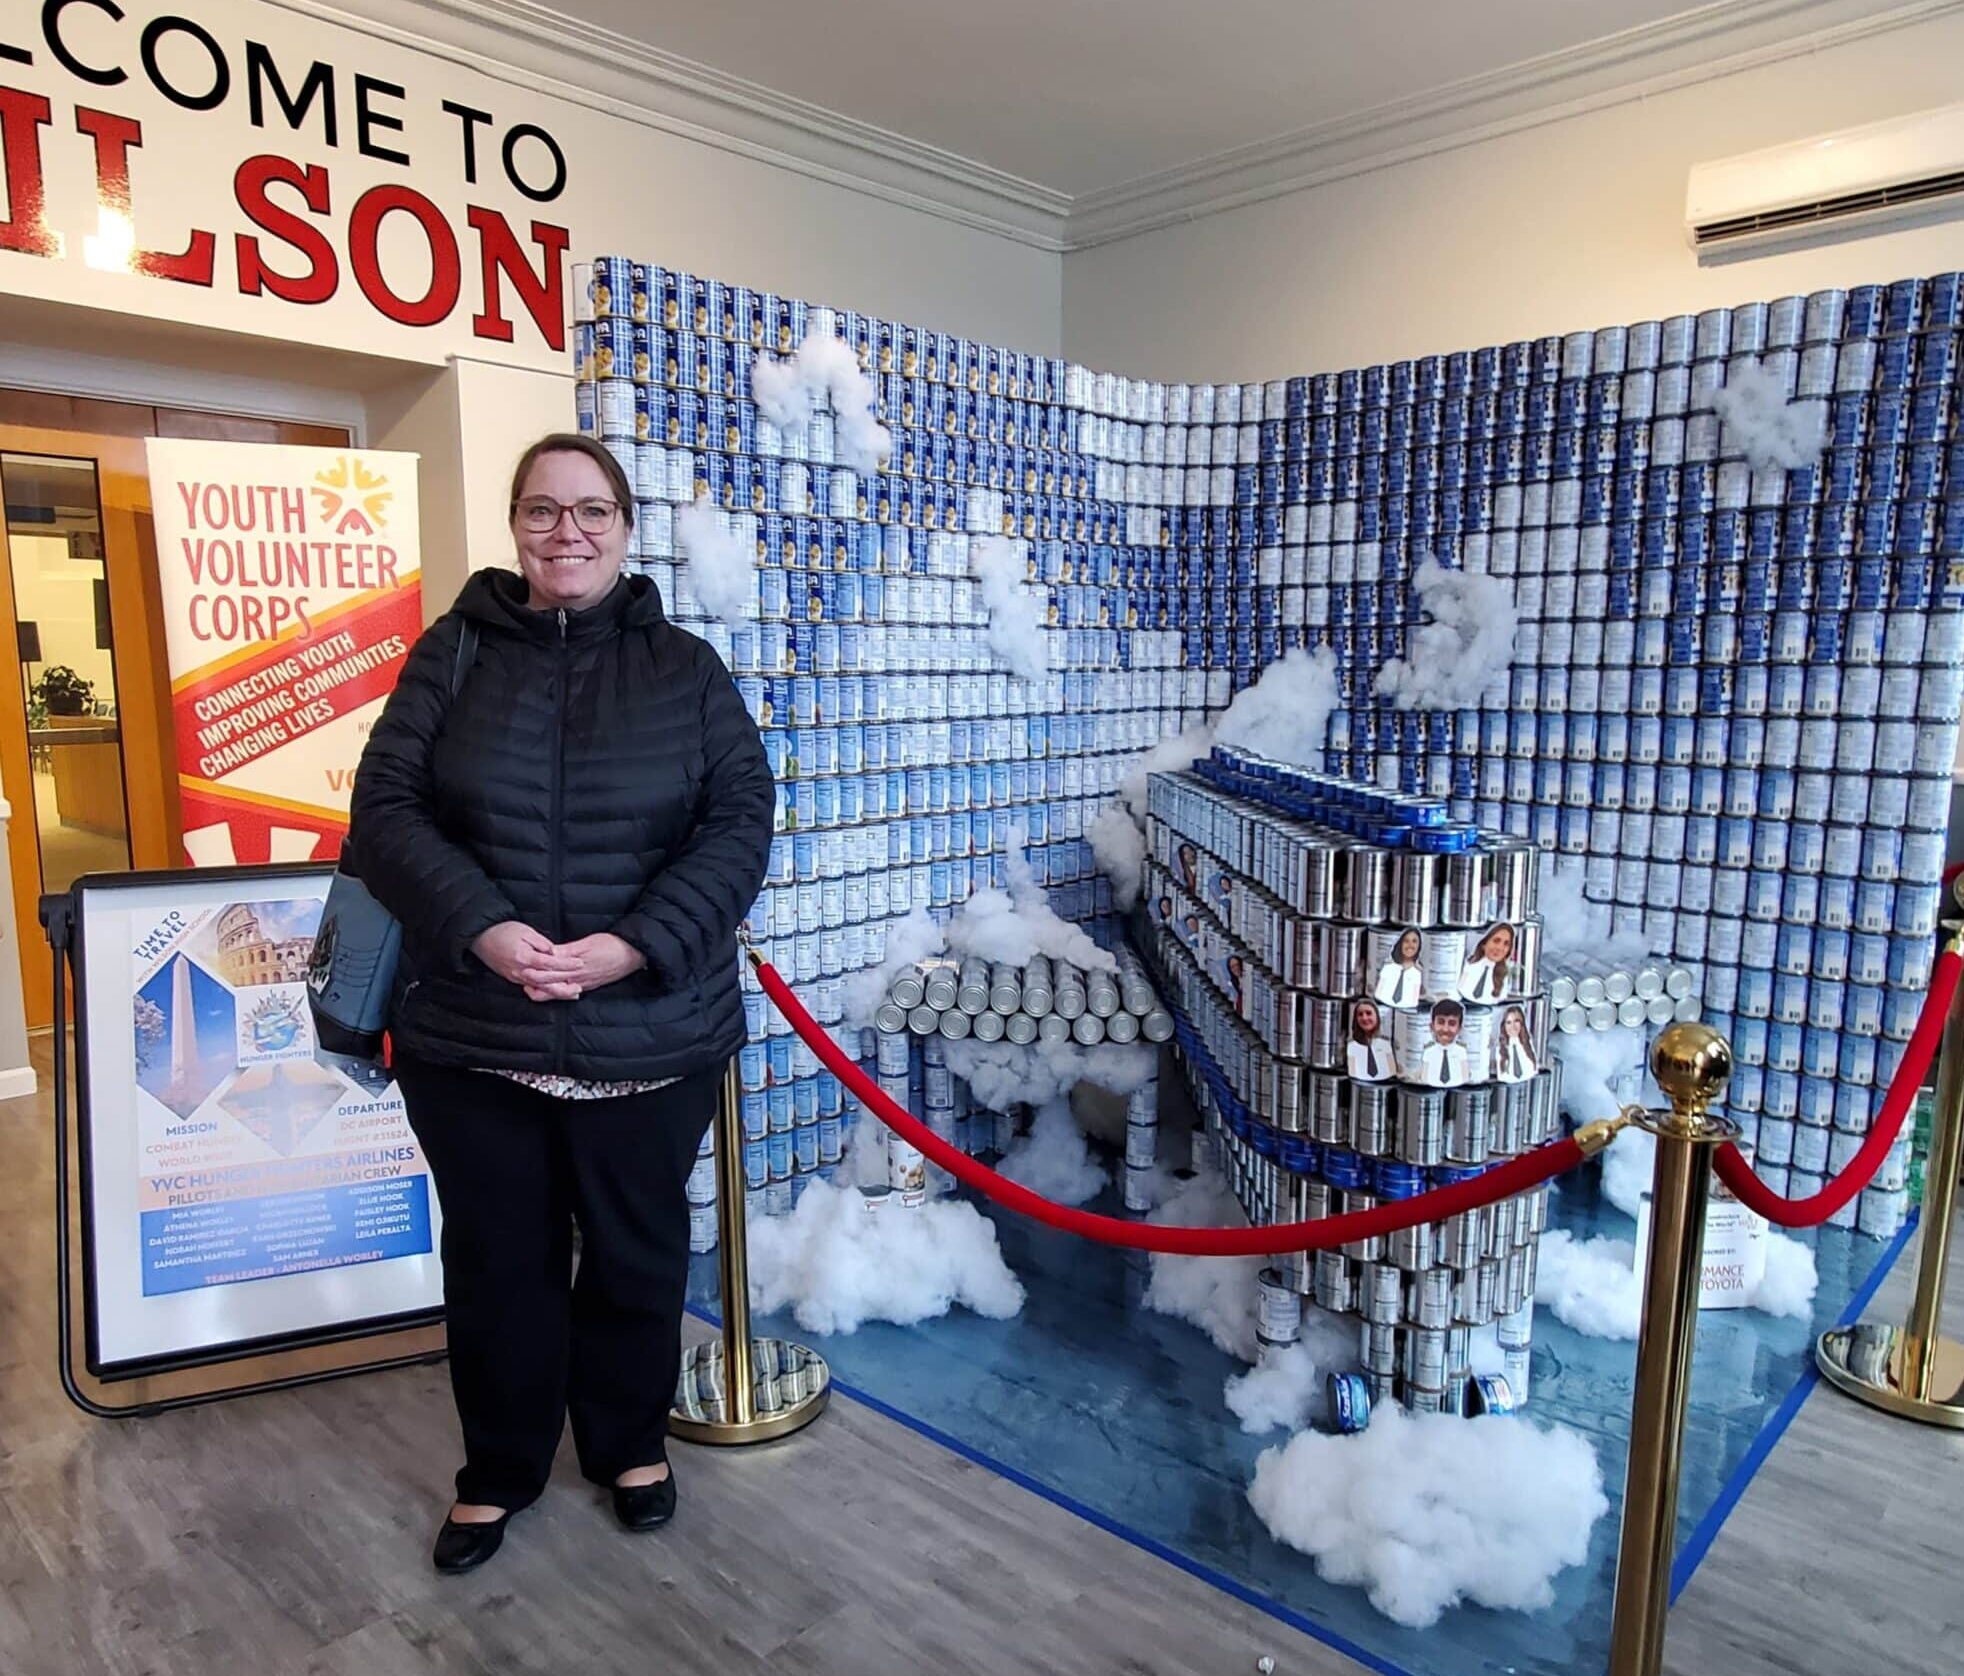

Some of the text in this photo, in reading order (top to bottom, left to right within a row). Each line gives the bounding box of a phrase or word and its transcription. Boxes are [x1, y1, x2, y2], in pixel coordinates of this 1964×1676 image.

[442, 98, 568, 203] TO
[177, 481, 307, 534] YOUTH
[181, 537, 399, 590] VOLUNTEER
[188, 594, 315, 642] CORPS
[194, 630, 357, 722] CONNECTING YOUTH
[197, 633, 408, 750] IMPROVING COMMUNITIES
[199, 696, 336, 779] CHANGING LIVES
[358, 721, 373, 733] HO
[324, 768, 355, 792] VO
[132, 910, 181, 957] TIME TO
[142, 919, 187, 961] TRAVEL
[338, 1100, 402, 1116] DEPARTURE
[358, 1115, 402, 1129] AIRPORT
[165, 1121, 218, 1137] MISSION
[145, 1139, 194, 1155] COMBAT
[158, 1154, 201, 1168] WORLD
[151, 1176, 186, 1193] YVC
[346, 1146, 415, 1167] AIRLINES
[363, 1164, 402, 1180] CREW
[148, 1235, 176, 1246] DAVID
[153, 1254, 202, 1269] SAMANTHA
[204, 1271, 234, 1284] TEAM
[235, 1265, 274, 1280] LEADER
[281, 1255, 342, 1273] ANTONELLA
